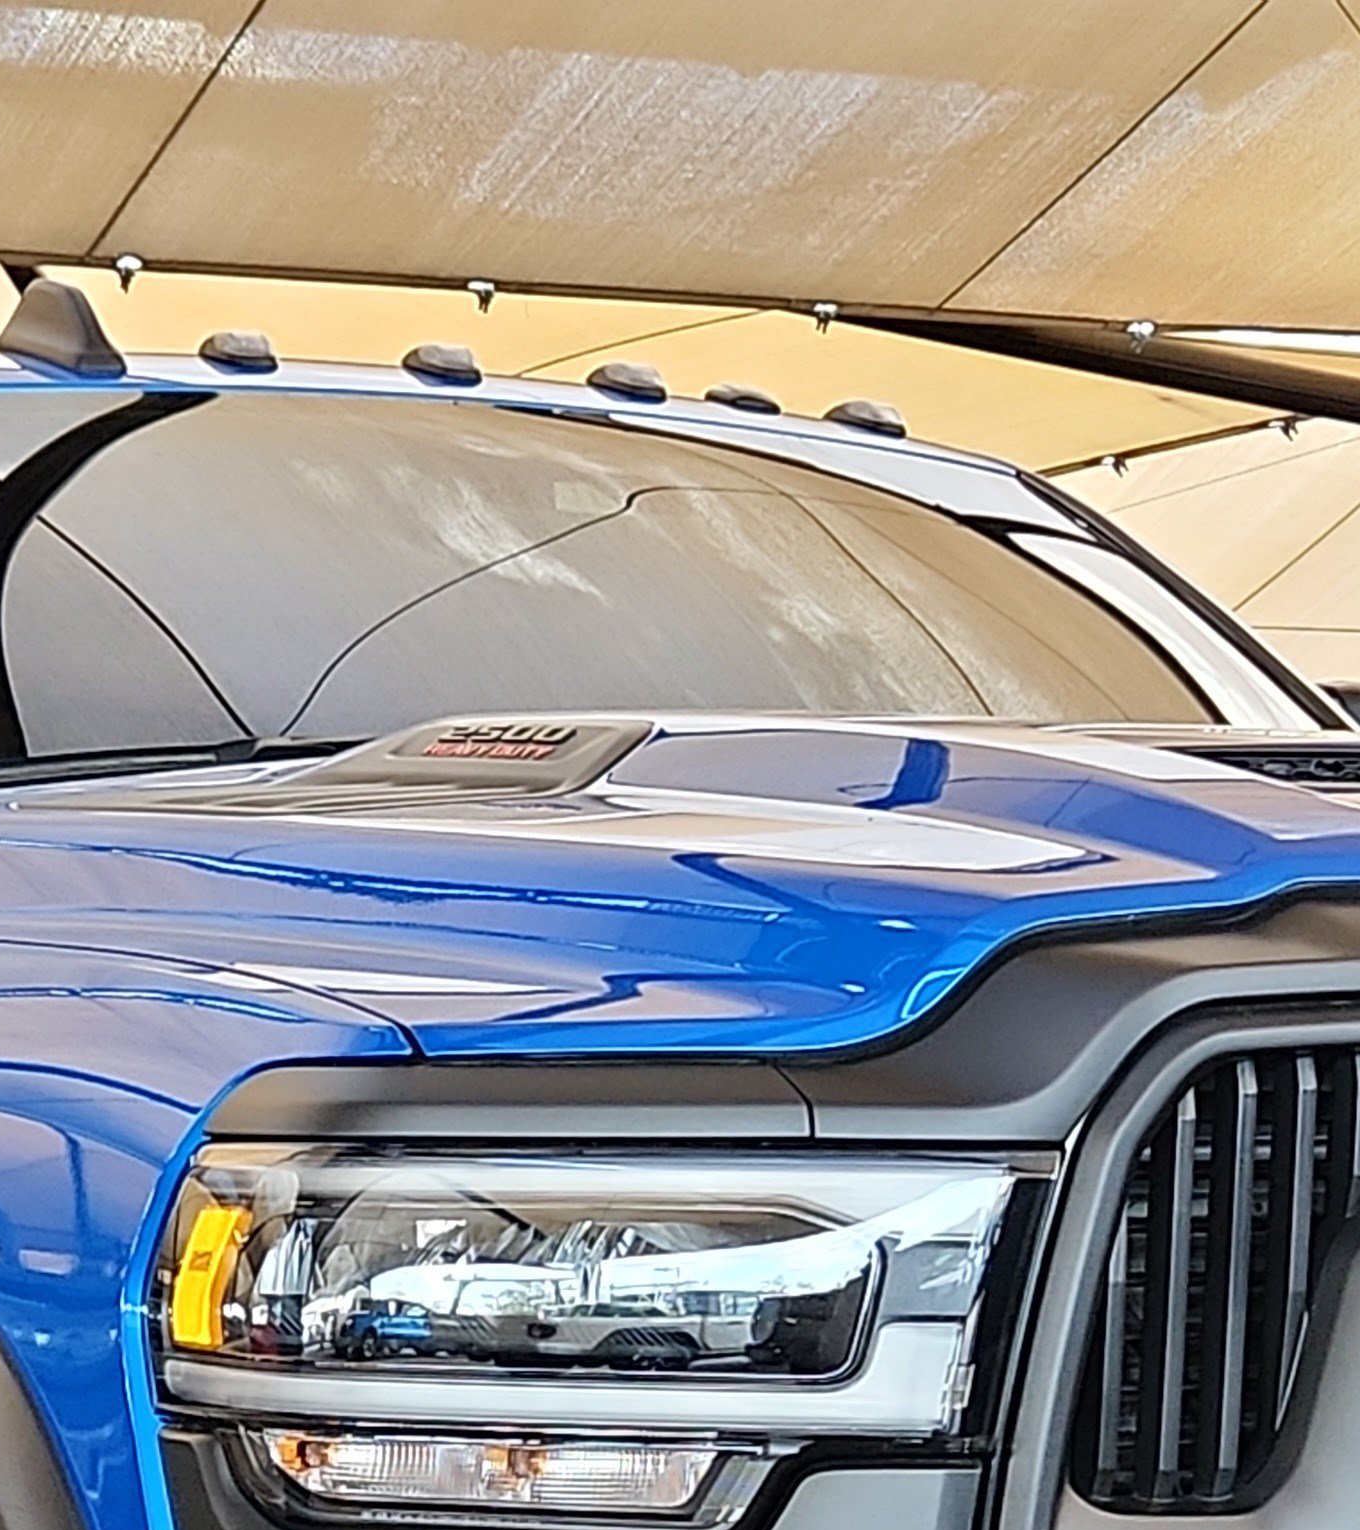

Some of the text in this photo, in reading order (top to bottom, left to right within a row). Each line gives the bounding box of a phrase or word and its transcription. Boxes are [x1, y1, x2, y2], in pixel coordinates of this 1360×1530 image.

[438, 725, 577, 744] 2500
[422, 742, 556, 761] HEAVY DUTY
